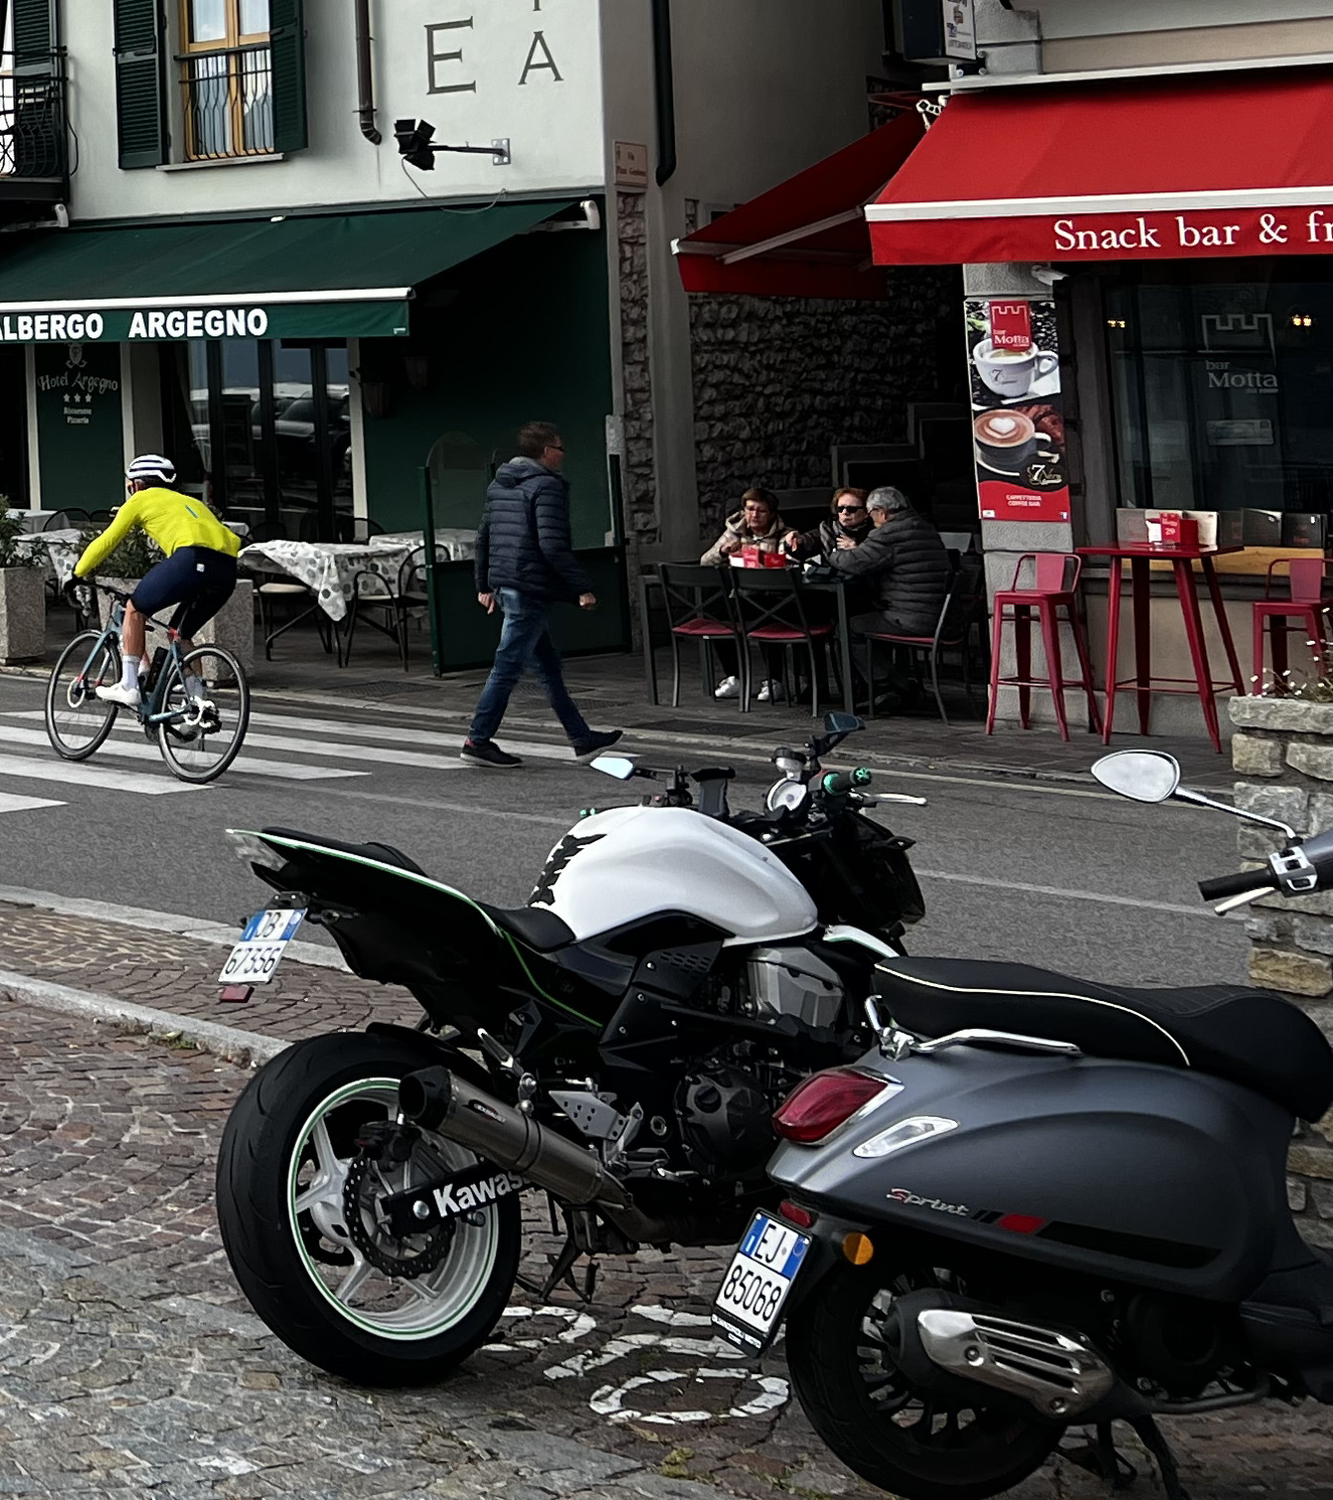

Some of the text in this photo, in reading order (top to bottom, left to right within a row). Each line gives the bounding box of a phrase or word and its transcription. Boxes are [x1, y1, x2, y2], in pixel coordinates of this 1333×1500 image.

[1054, 217, 1161, 250] Snack
[1176, 216, 1240, 247] bar
[1259, 213, 1288, 244] &
[128, 308, 268, 338] ARGEGNO
[994, 335, 1030, 344] Motta
[1206, 360, 1230, 370] bar
[1208, 372, 1278, 388] Motta
[225, 948, 281, 974] 67356
[433, 1171, 531, 1218] Kawas
[886, 1188, 969, 1216] Sprint
[754, 1223, 787, 1263] EJ
[723, 1264, 782, 1321] 85068
